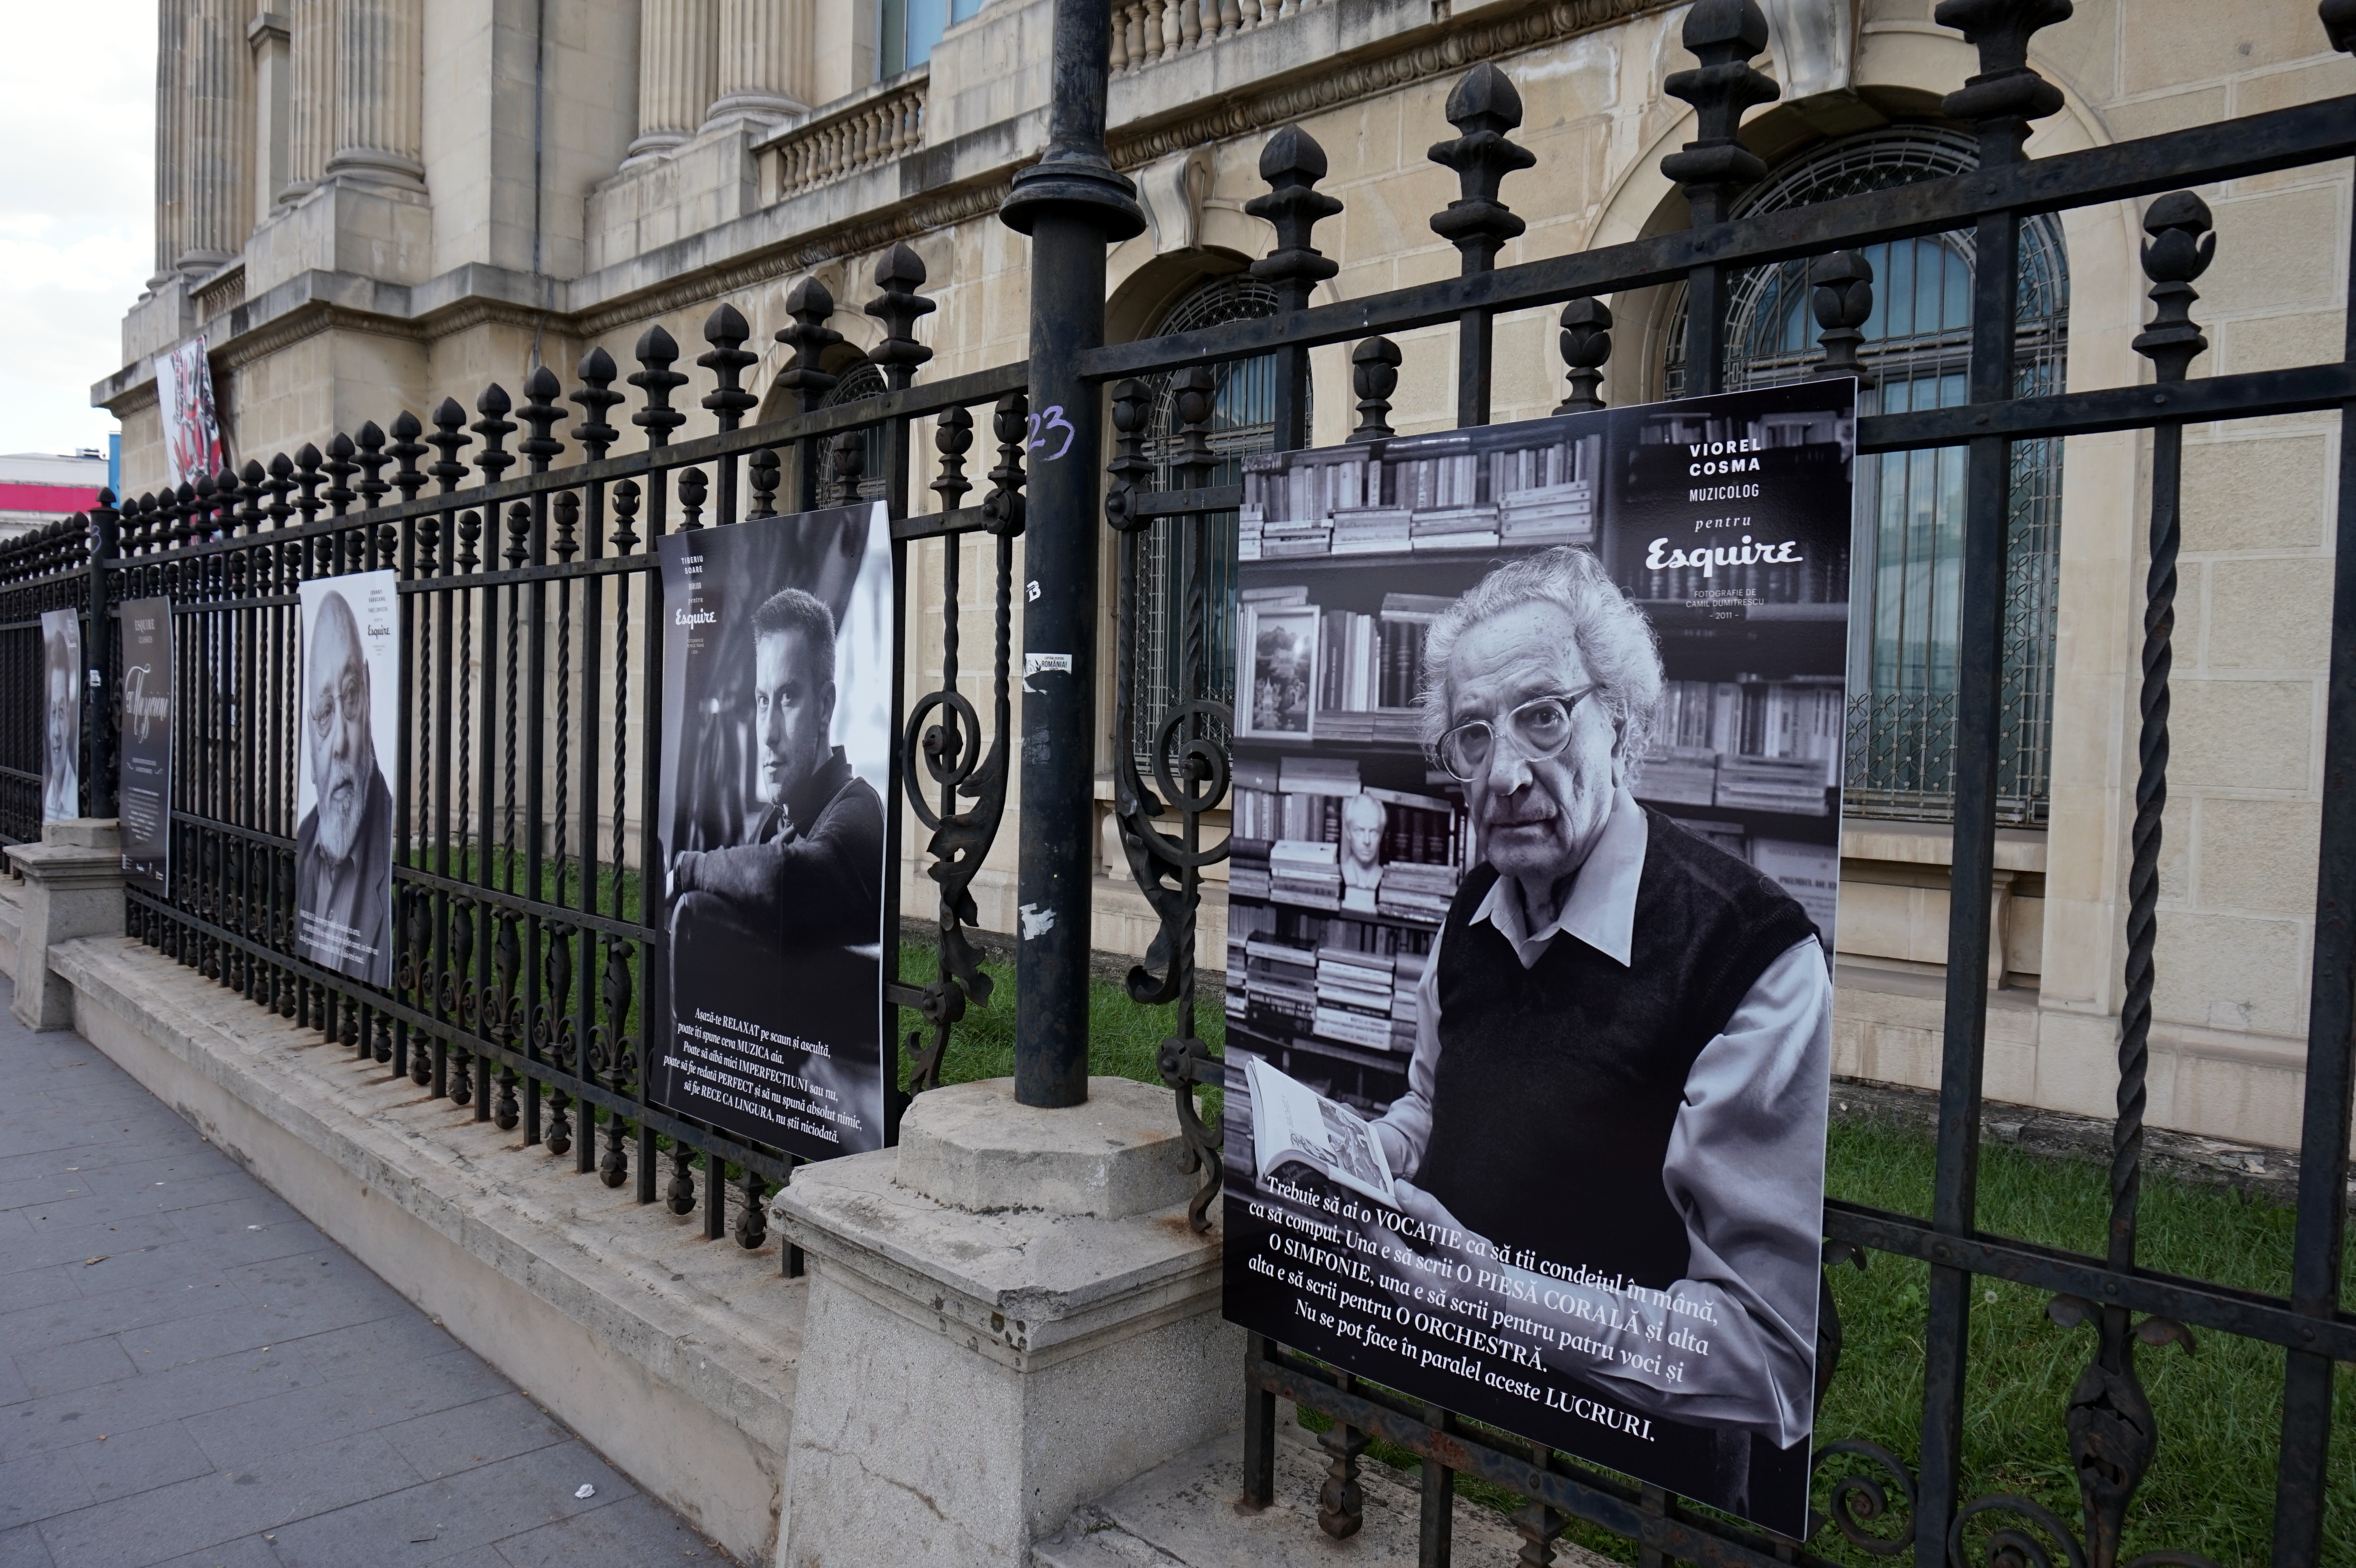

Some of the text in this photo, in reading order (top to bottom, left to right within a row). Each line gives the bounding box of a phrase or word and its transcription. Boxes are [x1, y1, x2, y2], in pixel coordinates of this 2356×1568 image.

[1028, 405, 1075, 462] 23
[1689, 438, 1761, 457] VIOREL
[1689, 458, 1761, 476] COSMA
[1689, 484, 1759, 502] MUZICOLOG
[1694, 516, 1751, 533] pentru
[681, 555, 703, 565] TIBERIU
[684, 566, 703, 575] SOARE
[1645, 535, 1803, 578] Esquire
[1685, 598, 1764, 608] CAMIL DUMITRESCU
[1694, 589, 1743, 598] FOTOGRAFIE
[135, 618, 155, 633] ESQUIRE
[368, 624, 390, 640] Esquire
[675, 608, 717, 630] Esquire
[1042, 659, 1067, 668] ROMÂNIA!
[678, 1023, 694, 1035] poate
[703, 1031, 720, 1044] spune
[721, 1037, 735, 1049] ceva
[737, 1039, 770, 1060] MUZICA
[771, 1050, 784, 1064] aia.
[695, 1008, 830, 1059] Așază-te RELAXAT pe scaun și ascultă,
[683, 1040, 838, 1103] Poate să aibă mici IMPERFECȚIUNI sau nu,
[663, 1055, 862, 1132] poate să fie redată PERFECT și să nu spună absolut nimic,
[684, 1080, 839, 1144] să fie RECE CA LINGURA, nu știi niciodată.
[1267, 1175, 1320, 1208] Trebuie
[1323, 1195, 1340, 1214] să
[1343, 1202, 1358, 1220] ai
[1361, 1210, 1371, 1223] o
[1376, 1208, 1462, 1250] VOCAȚIE
[1466, 1239, 1485, 1257] ca
[1490, 1243, 1511, 1264] să
[1515, 1249, 1536, 1271] ții
[1539, 1260, 1622, 1295] condeiul
[1627, 1278, 1647, 1303] în
[1653, 1291, 1718, 1326] mână,
[1249, 1201, 1709, 1356] ca să compui. Una e să scrii O PIESĂ CORALĂ și alta
[1248, 1254, 1547, 1372] alta e să scrii pentru O ORCHESTRĂ.
[1269, 1233, 1684, 1384] O SIMFONIE, una e să scrii pentru patru voci și
[1295, 1299, 1655, 1442] Nu se pot face în paralel aceste LUCRURI.
